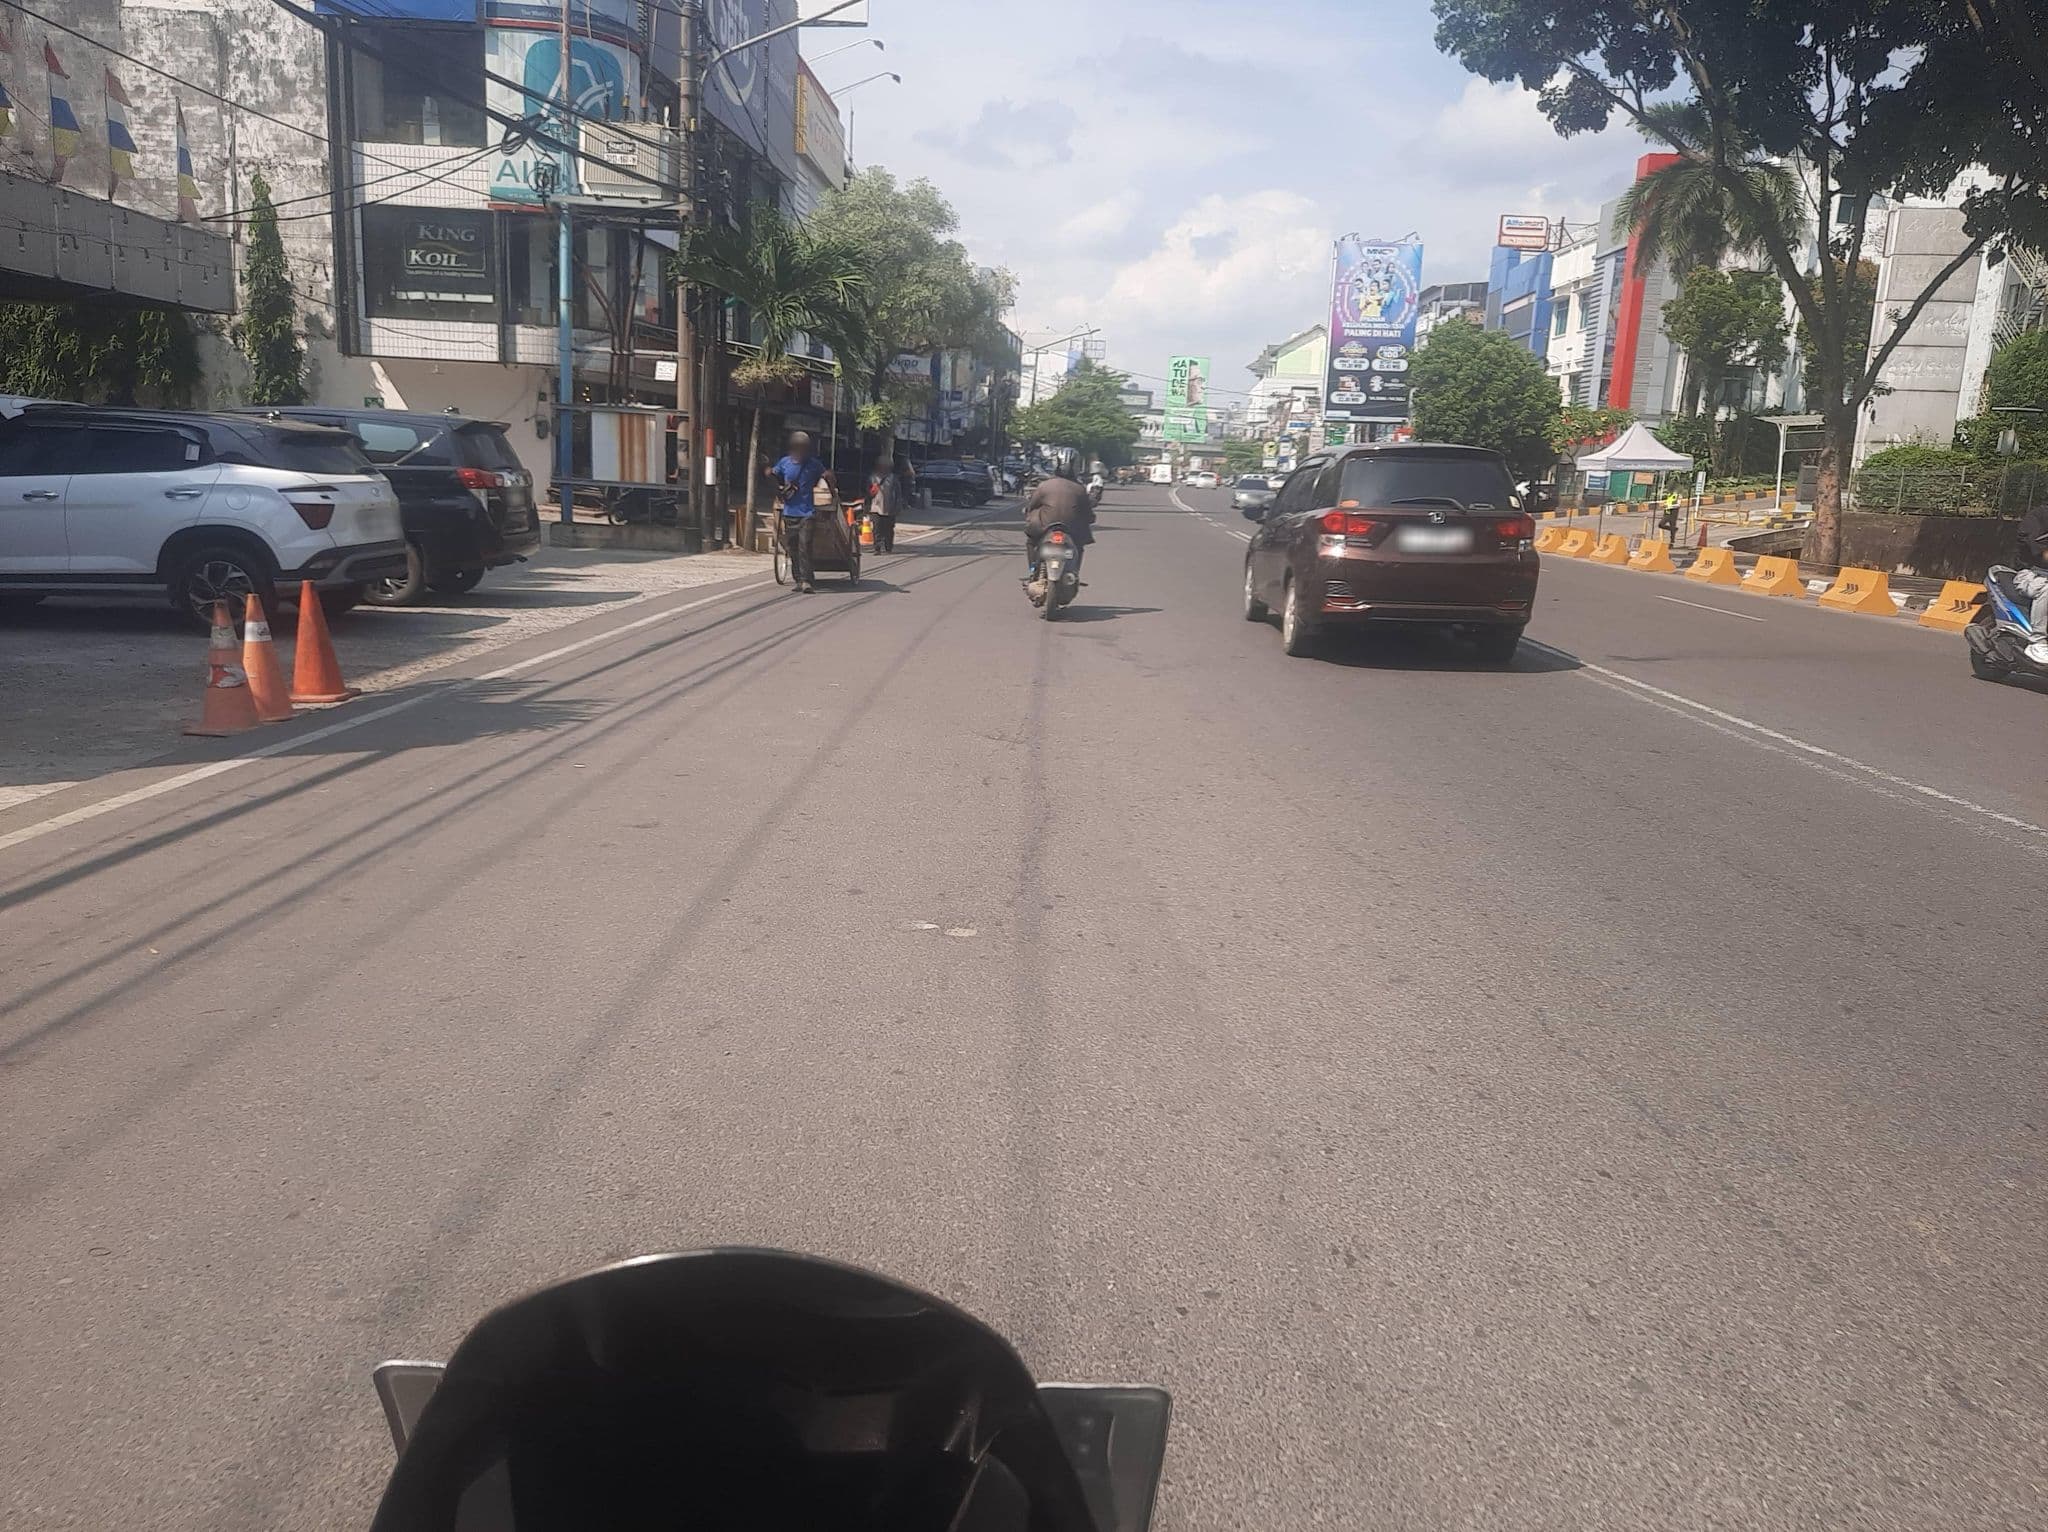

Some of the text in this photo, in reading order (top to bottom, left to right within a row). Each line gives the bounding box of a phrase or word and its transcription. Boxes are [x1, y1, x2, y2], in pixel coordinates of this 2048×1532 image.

[417, 225, 476, 242] KING
[408, 249, 467, 267] KOIL
[1172, 369, 1187, 378] TU
[1172, 379, 1186, 388] DE
